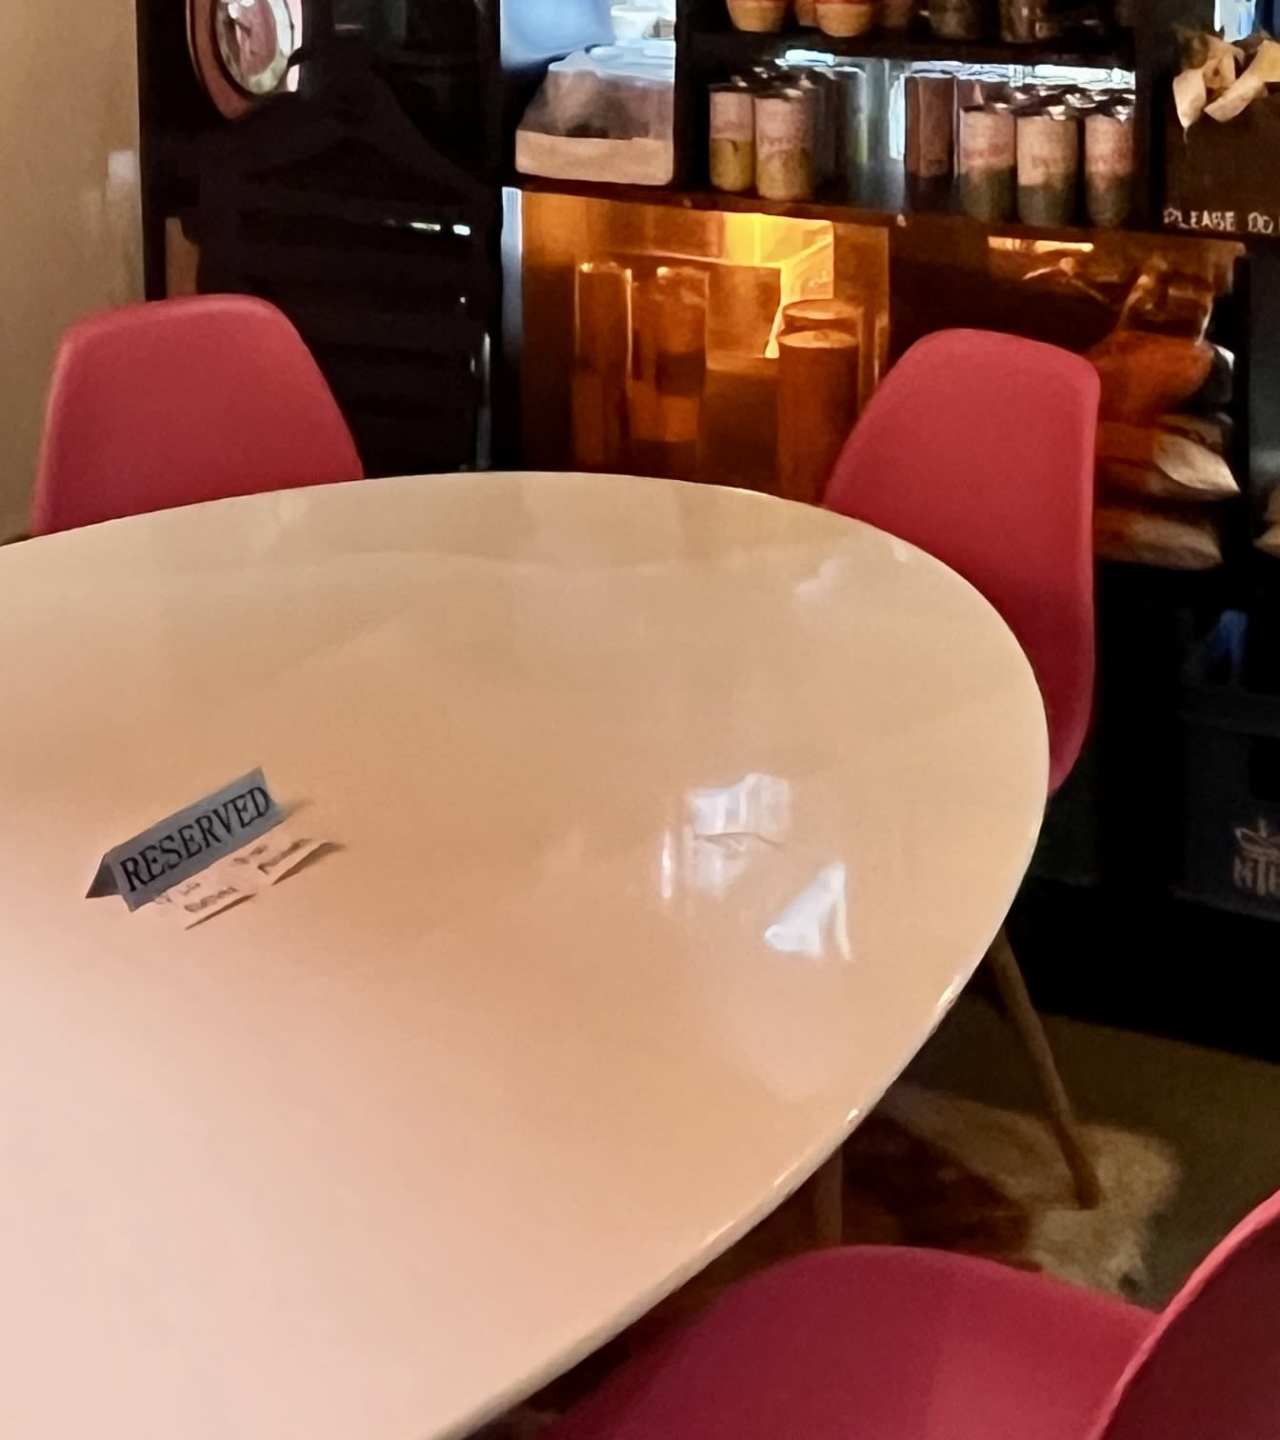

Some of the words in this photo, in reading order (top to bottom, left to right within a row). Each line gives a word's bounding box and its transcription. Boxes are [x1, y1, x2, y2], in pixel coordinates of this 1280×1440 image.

[1163, 207, 1236, 233] PLEASE
[1247, 211, 1274, 235] DO
[120, 785, 271, 893] RESERVED
